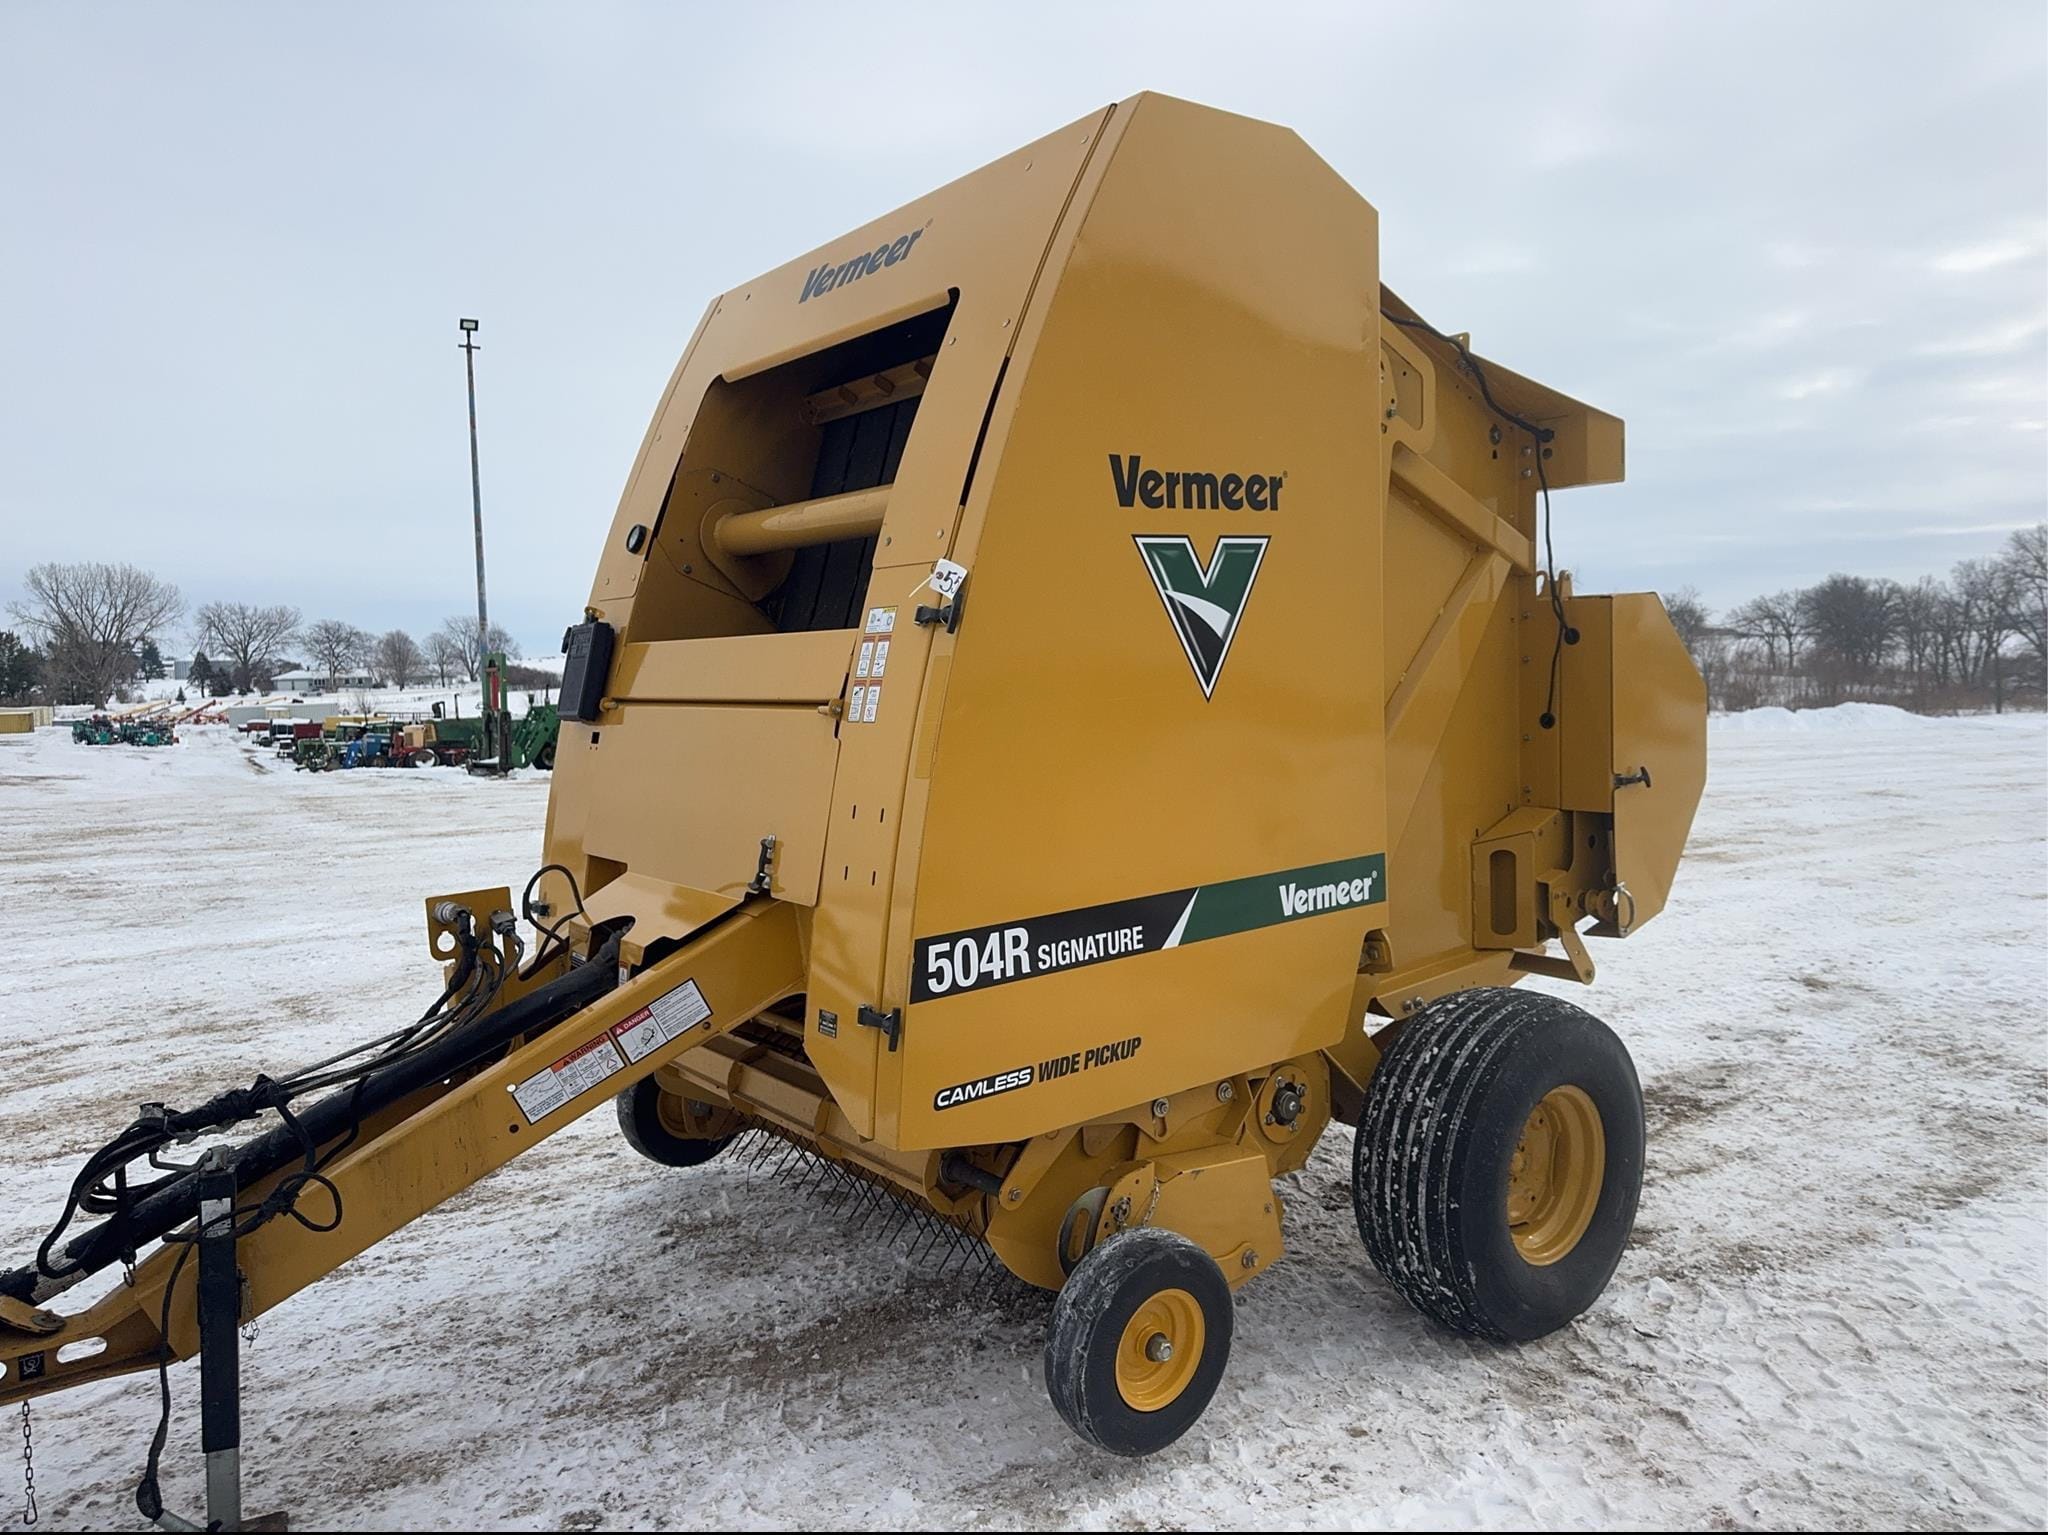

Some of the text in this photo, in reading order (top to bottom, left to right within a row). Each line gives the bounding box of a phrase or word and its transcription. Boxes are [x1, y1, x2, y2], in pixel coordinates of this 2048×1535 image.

[798, 228, 924, 304] Vermeer
[1108, 453, 1284, 512] Vermeer
[1278, 876, 1373, 917] Vermeer
[927, 925, 1145, 994] 504R SIGNATURE
[622, 1009, 651, 1030] DANGER
[569, 1037, 607, 1063] WARNING
[936, 1036, 1142, 1108] CAMLESS WIDE PICKUP
